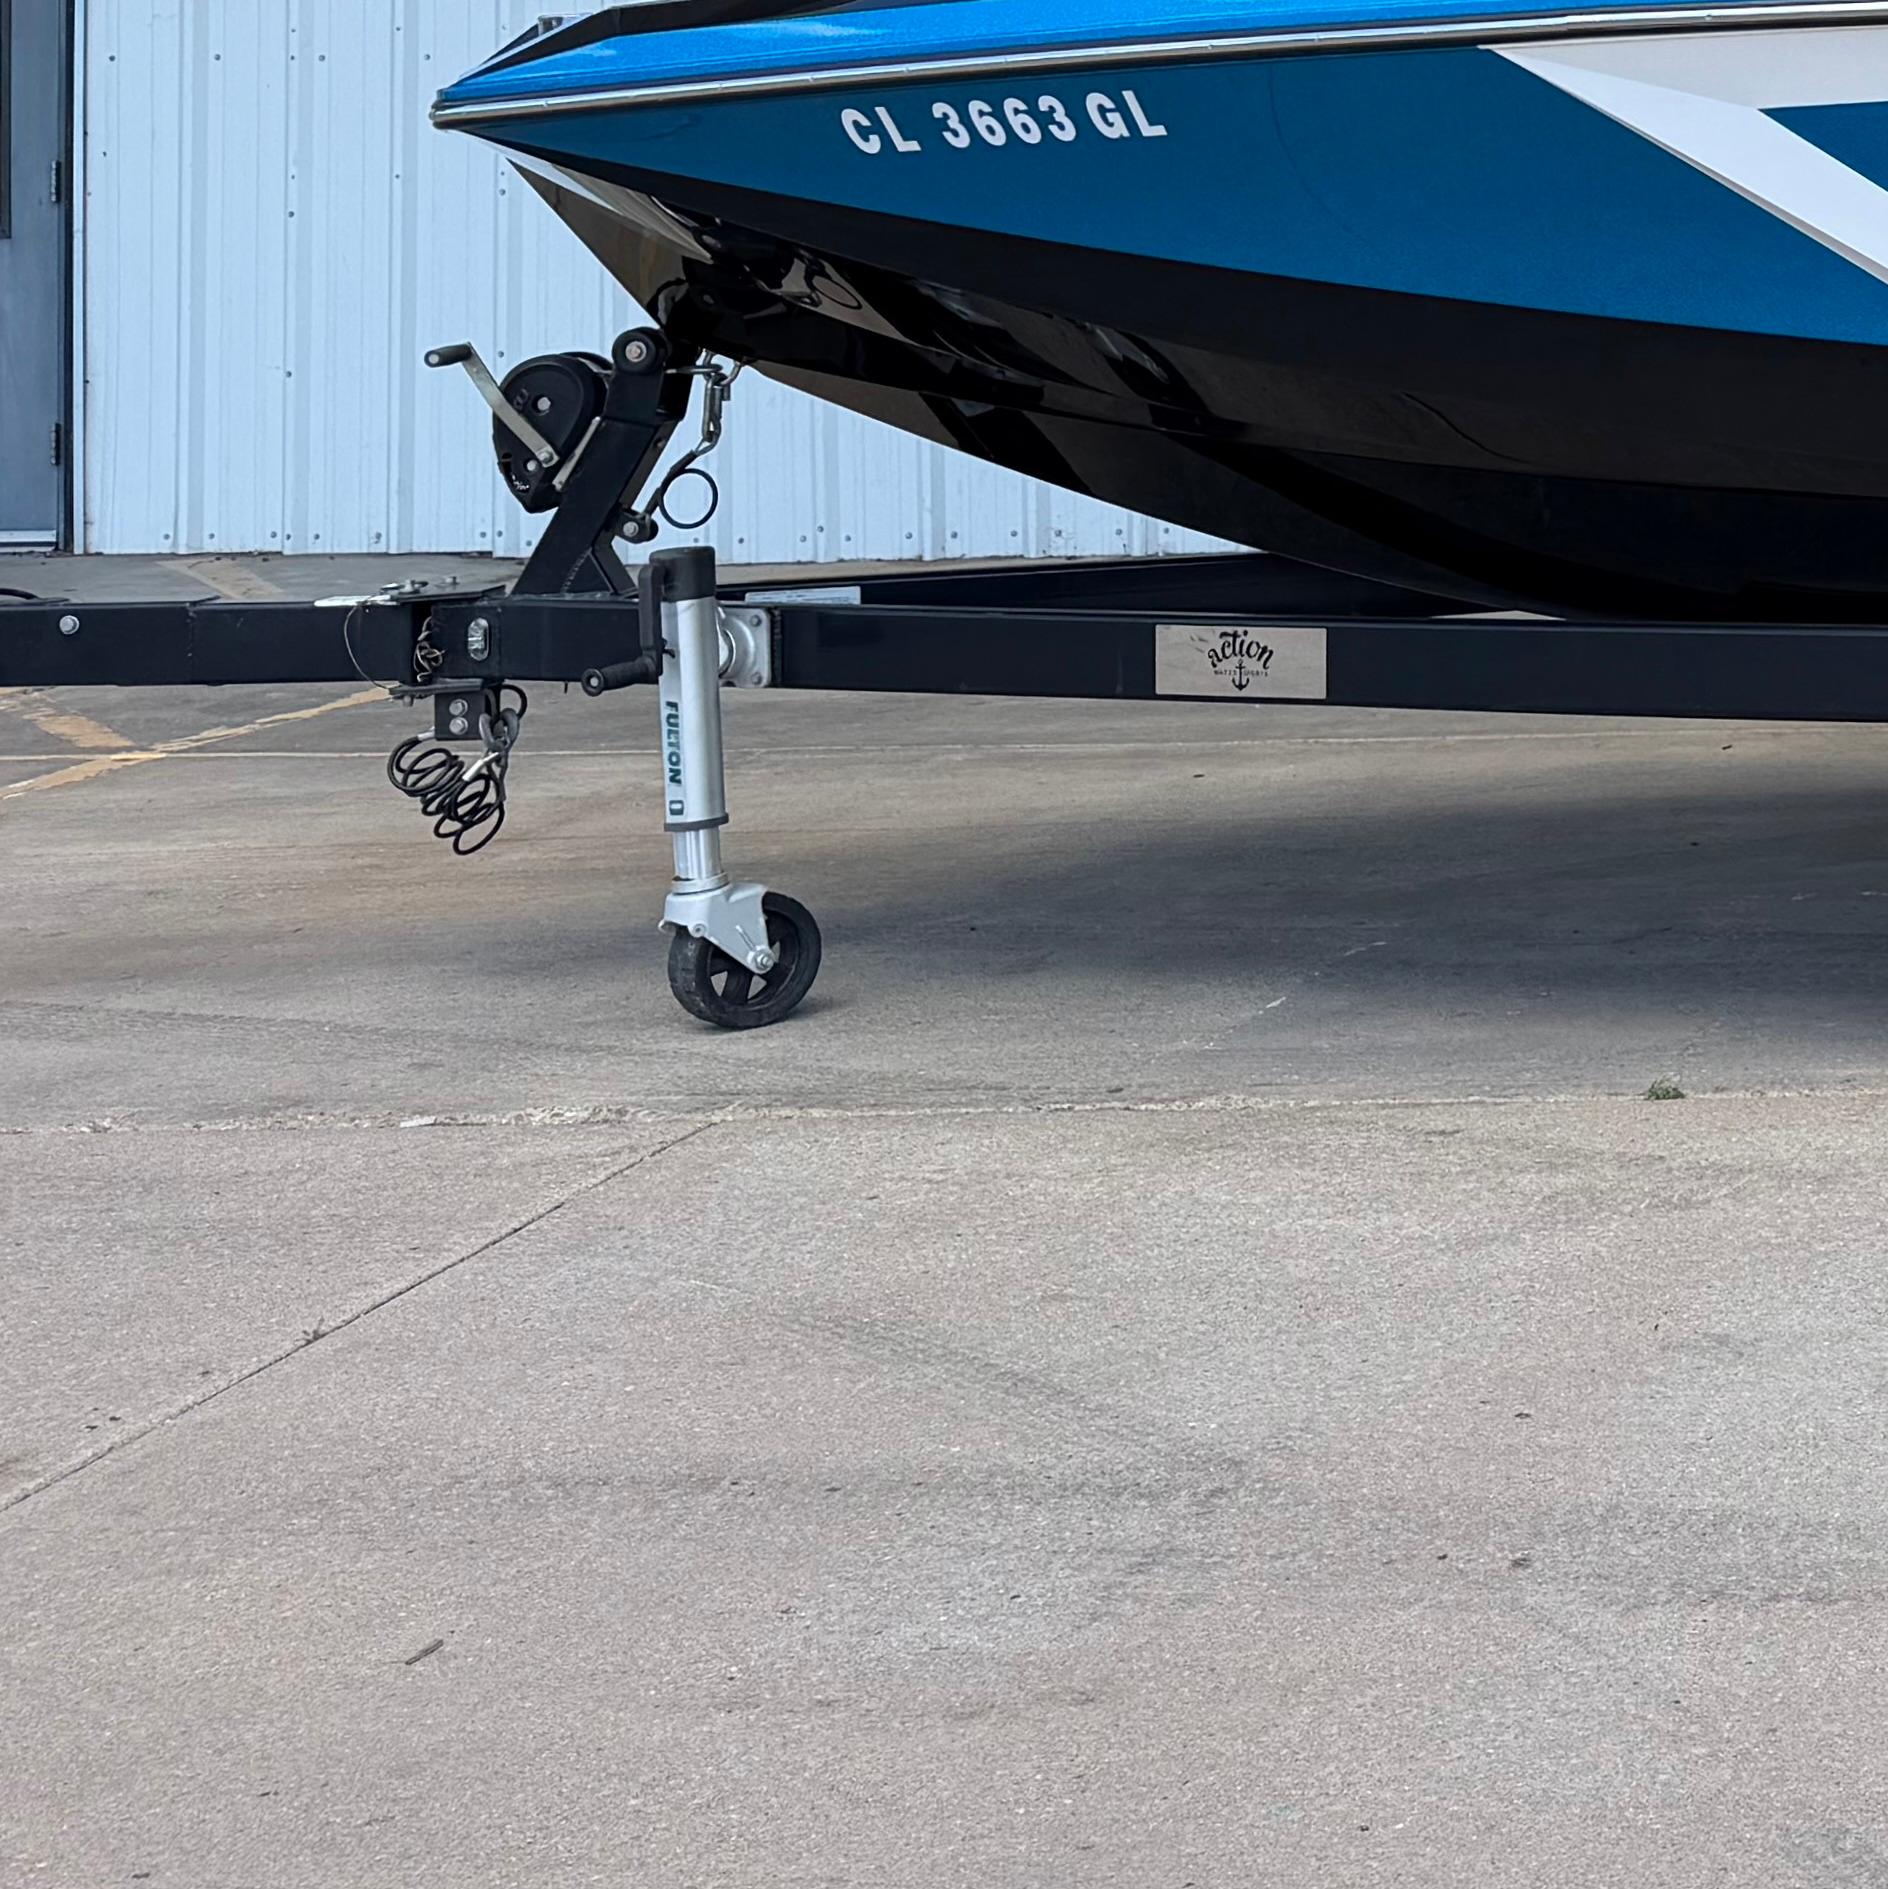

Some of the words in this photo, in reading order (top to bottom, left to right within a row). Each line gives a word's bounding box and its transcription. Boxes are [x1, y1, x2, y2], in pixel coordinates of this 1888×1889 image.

[840, 105, 921, 154] CL
[932, 94, 1077, 150] 3663
[1085, 89, 1168, 140] GL
[1207, 629, 1274, 670] action
[665, 700, 682, 786] FULTON
